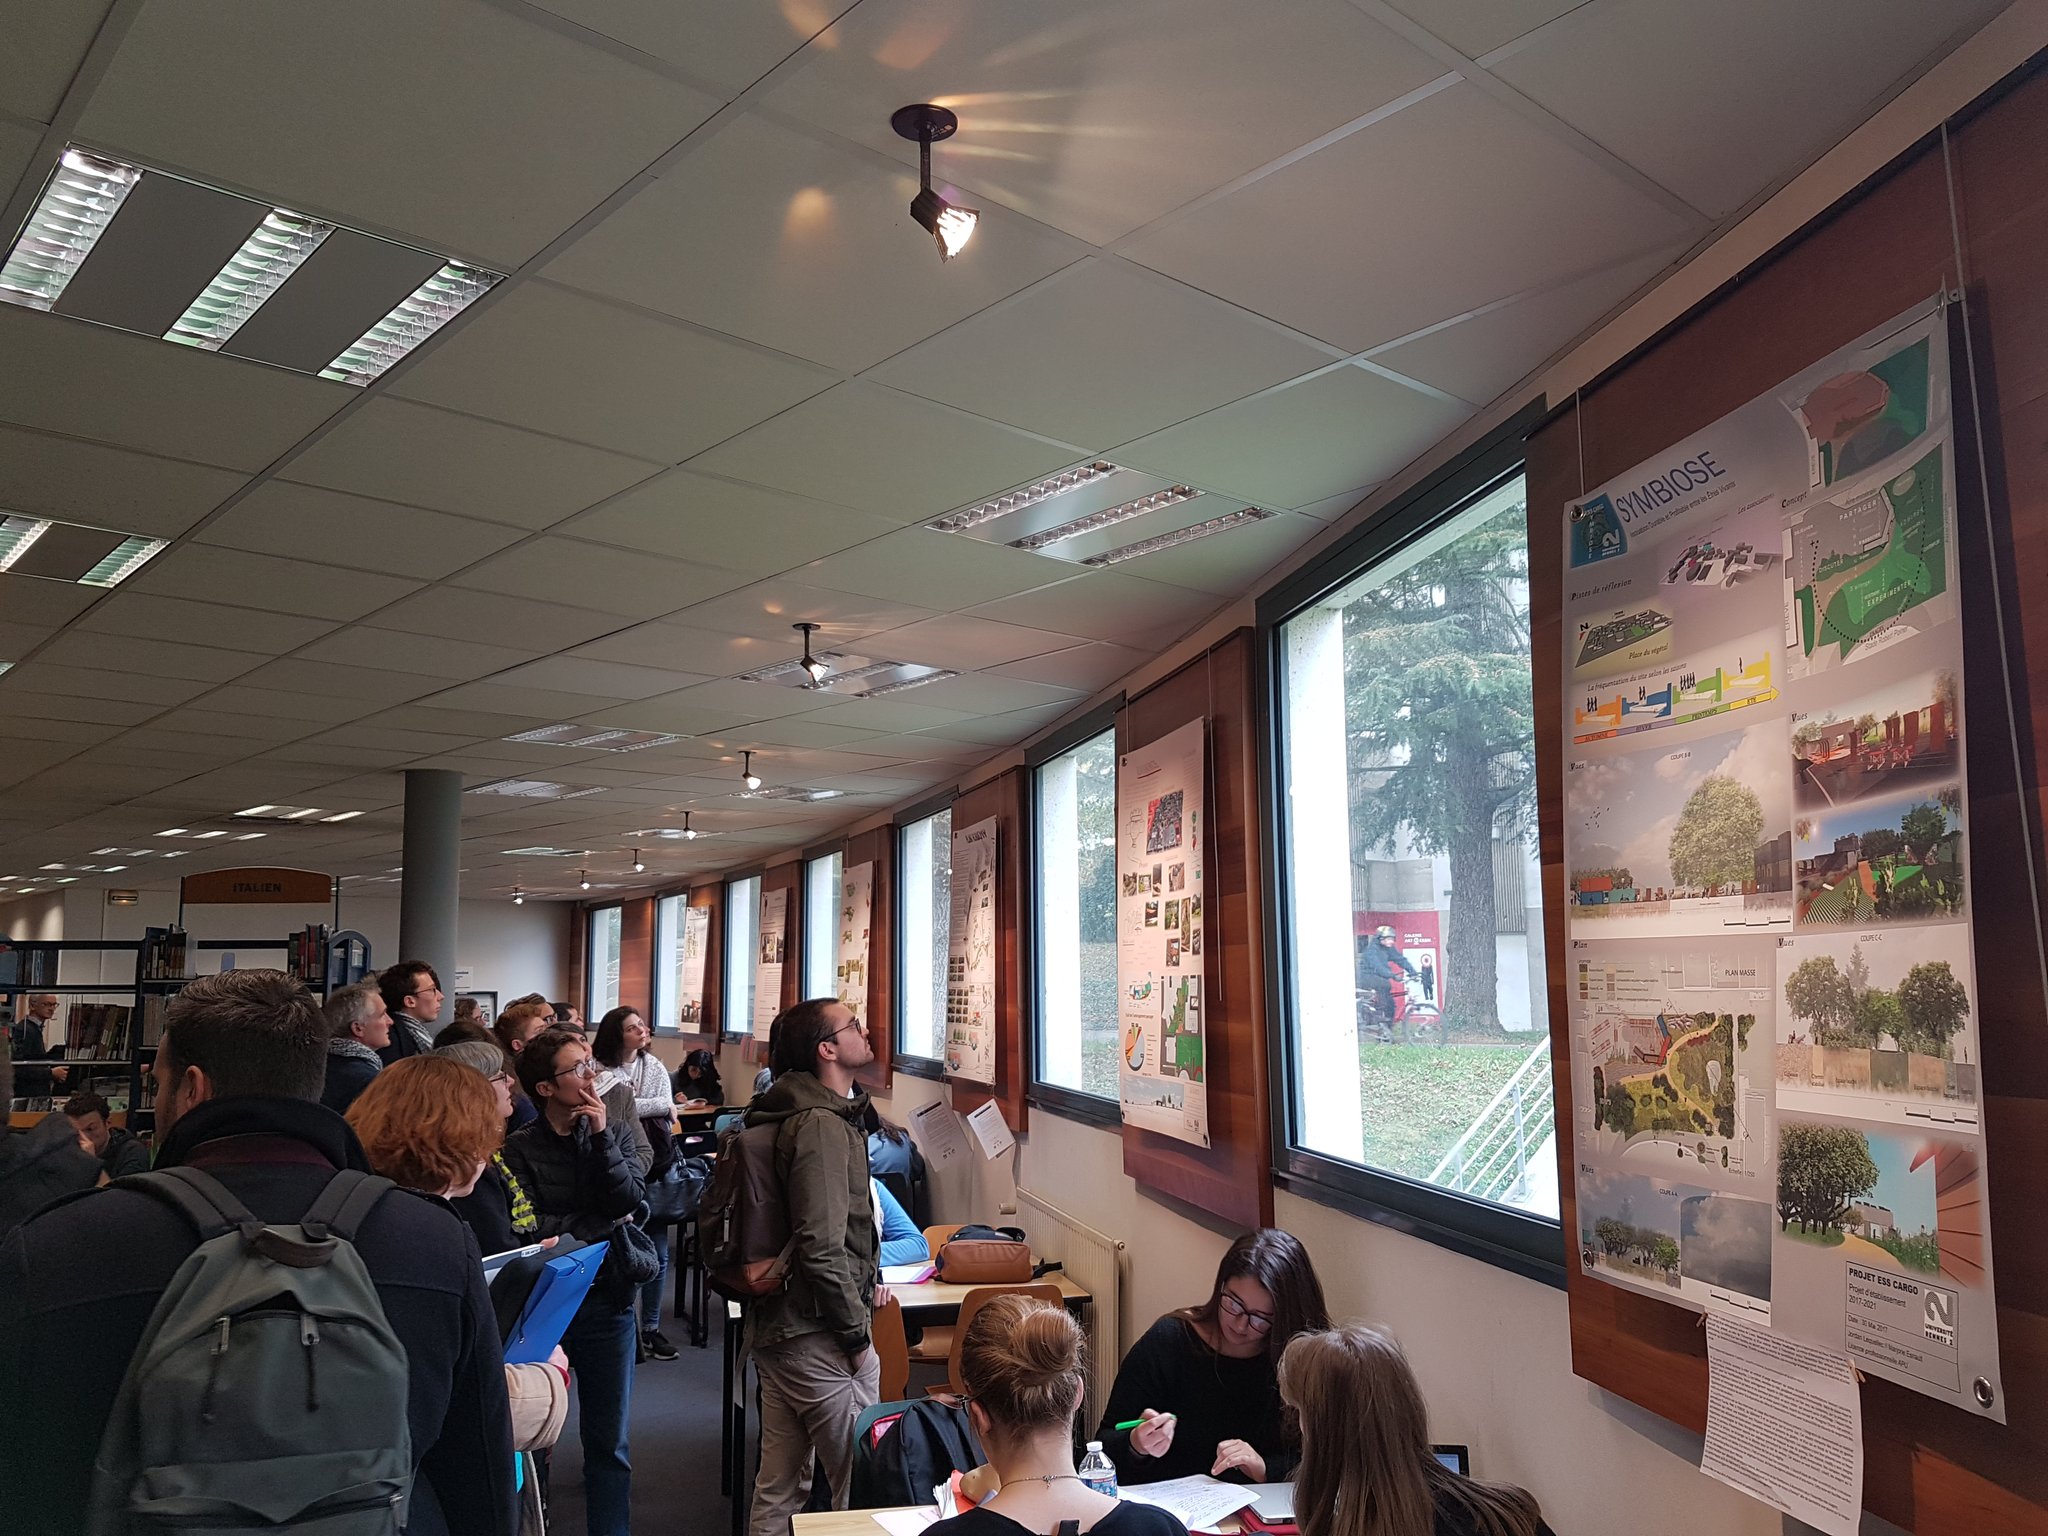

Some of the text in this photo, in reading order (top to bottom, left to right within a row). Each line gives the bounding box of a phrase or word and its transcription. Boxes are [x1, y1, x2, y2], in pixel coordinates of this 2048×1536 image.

[1616, 451, 1726, 523] SYMBIOSE
[1781, 490, 1807, 508] Concept
[1839, 499, 1878, 521] PARTAGER
[1571, 578, 1632, 601] Pistes de réflexion
[1629, 643, 1669, 660] Place du végétal
[1587, 683, 1594, 692] La
[1594, 676, 1630, 692] fréquentation
[1630, 674, 1637, 682] du
[1648, 669, 1662, 679] selon
[1662, 667, 1670, 675] les
[1791, 713, 1808, 723] Vues
[1670, 752, 1684, 761] COUPE
[1570, 762, 1584, 770] Vues
[233, 882, 281, 893] ITALIEN
[1777, 937, 1794, 947] Vues
[1860, 934, 1875, 942] COUPE
[1573, 941, 1588, 950] Plan
[1725, 969, 1756, 977] PLAN MASSE
[1659, 1188, 1671, 1196] COUPE
[1848, 1267, 1919, 1295] PROJET ESS CARGO
[1848, 1283, 1865, 1296] Projet
[1848, 1295, 1877, 1310] 2017-2021
[1925, 1322, 1954, 1338] UNIVERSITÉ
[1925, 1331, 1947, 1344] RENNES
